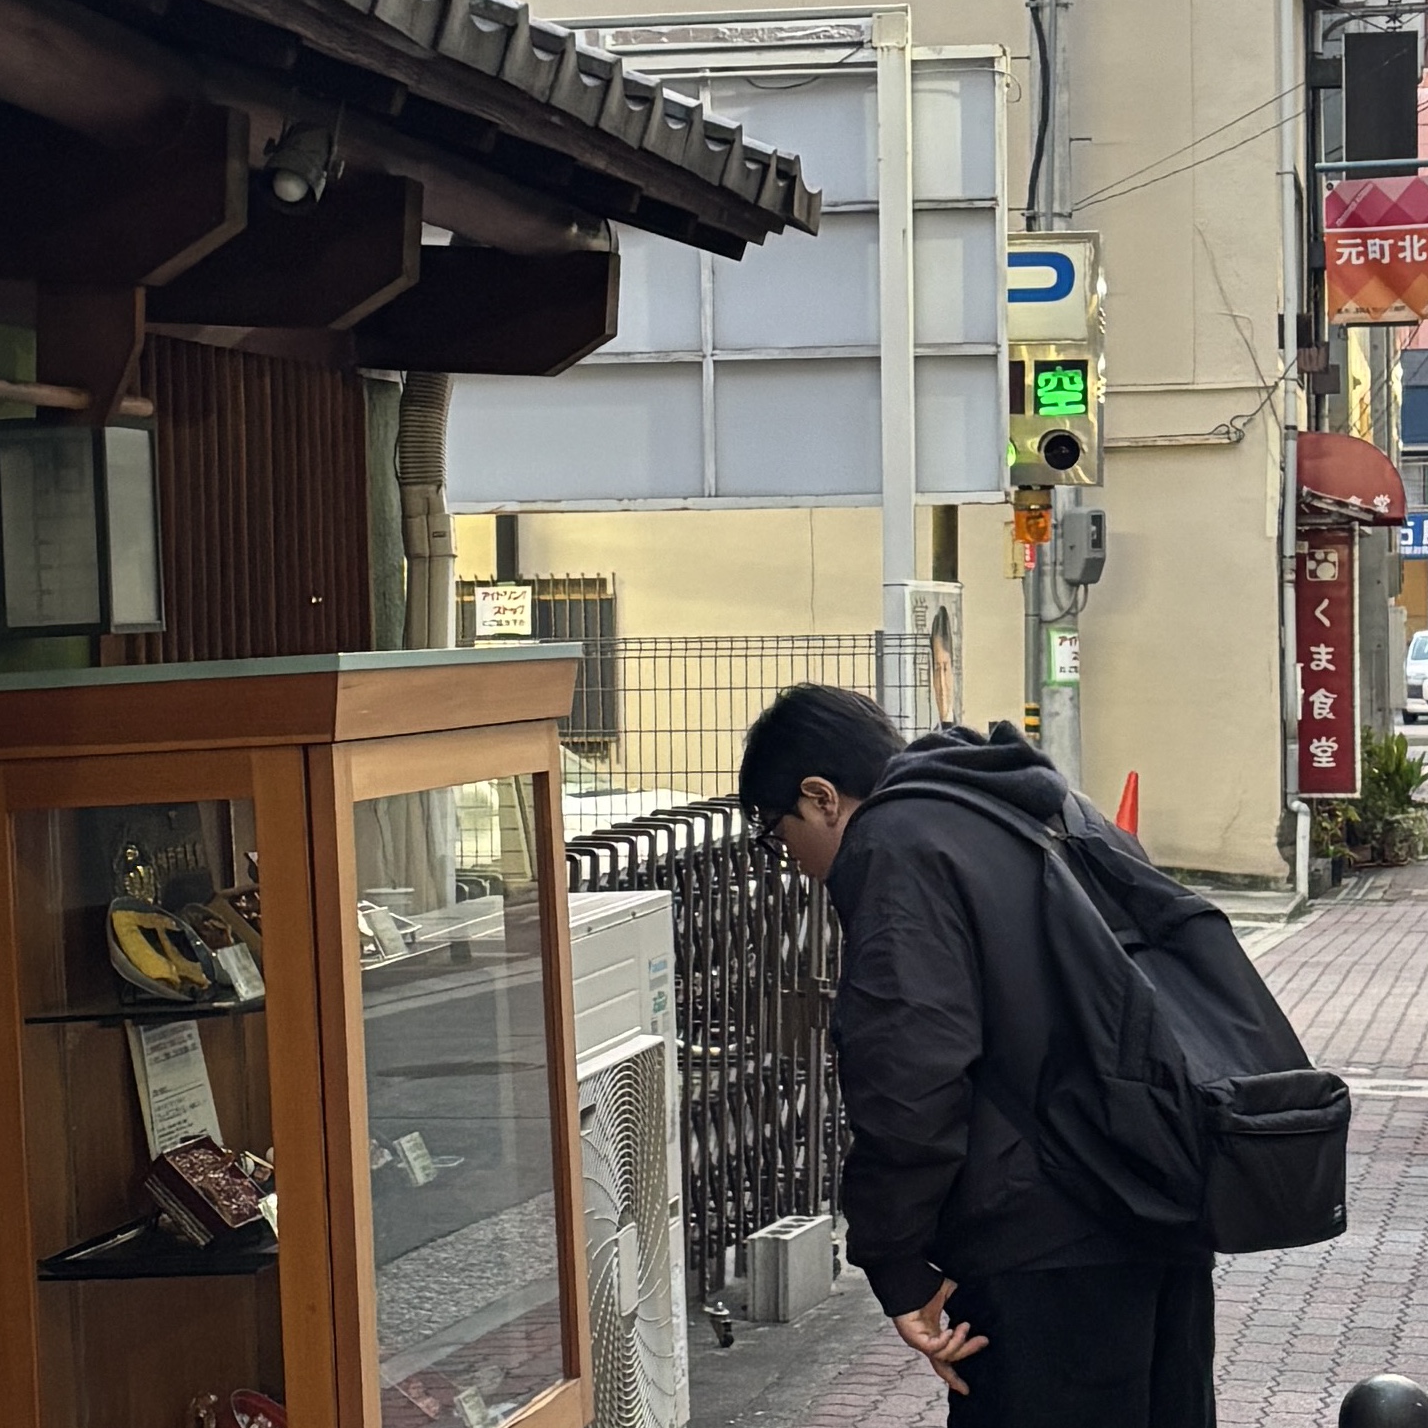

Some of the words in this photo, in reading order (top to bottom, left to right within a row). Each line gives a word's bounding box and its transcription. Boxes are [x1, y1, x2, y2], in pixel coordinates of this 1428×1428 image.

[1037, 366, 1086, 416] 空
[1308, 597, 1339, 768] くま食堂
